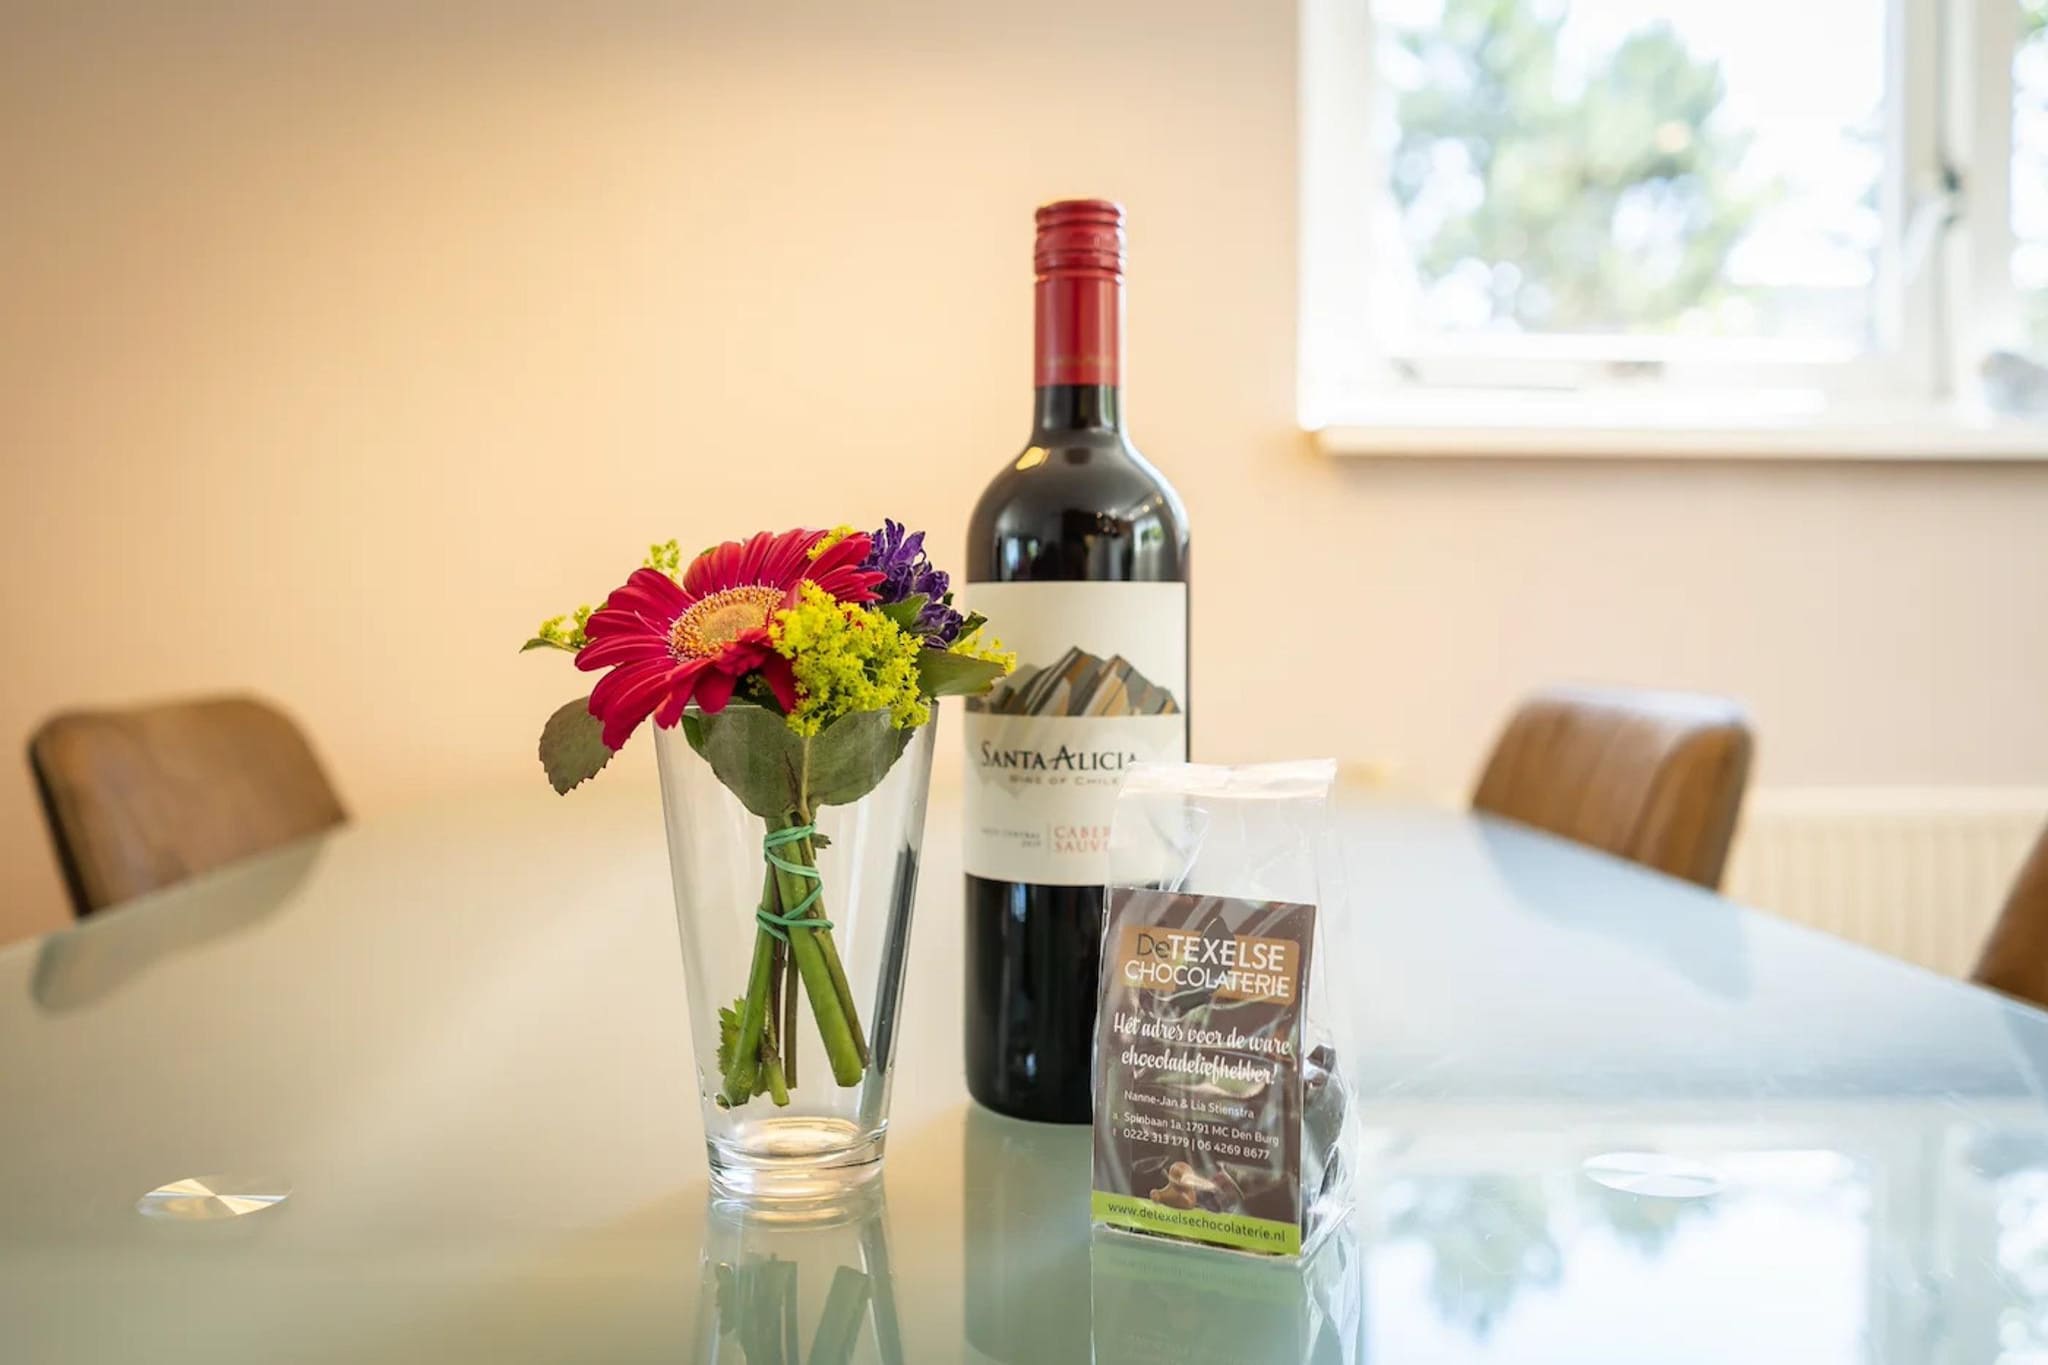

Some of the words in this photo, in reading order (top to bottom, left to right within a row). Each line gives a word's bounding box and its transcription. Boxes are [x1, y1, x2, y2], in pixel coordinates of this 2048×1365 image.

[981, 740, 1047, 770] SANTA
[1049, 776, 1067, 785] OF
[1124, 960, 1291, 998] CHOCOLATERIE
[1113, 1011, 1141, 1035] Het
[1141, 1017, 1183, 1041] adres
[1187, 1028, 1222, 1045] voor
[1226, 1026, 1246, 1050] de
[1248, 1037, 1293, 1056] ware
[1121, 1044, 1279, 1085] chocoladeliefhebber!
[1123, 1090, 1178, 1108] Nanne-Jan
[1180, 1098, 1188, 1110] &
[1207, 1102, 1255, 1119] Stienstra
[1123, 1111, 1169, 1130] Spinbaan
[1186, 1121, 1209, 1135] 1791
[1211, 1124, 1230, 1138] MC
[1231, 1127, 1252, 1141] Den
[1254, 1131, 1280, 1149] Burg
[1123, 1127, 1150, 1142] 0222
[1151, 1132, 1170, 1145] 313
[1171, 1135, 1190, 1148] 179
[1196, 1140, 1212, 1152] 06
[1213, 1142, 1241, 1156] 4269
[1242, 1147, 1271, 1161] 8677
[1107, 1202, 1286, 1243] www.detexelsechocolaterie.nl
